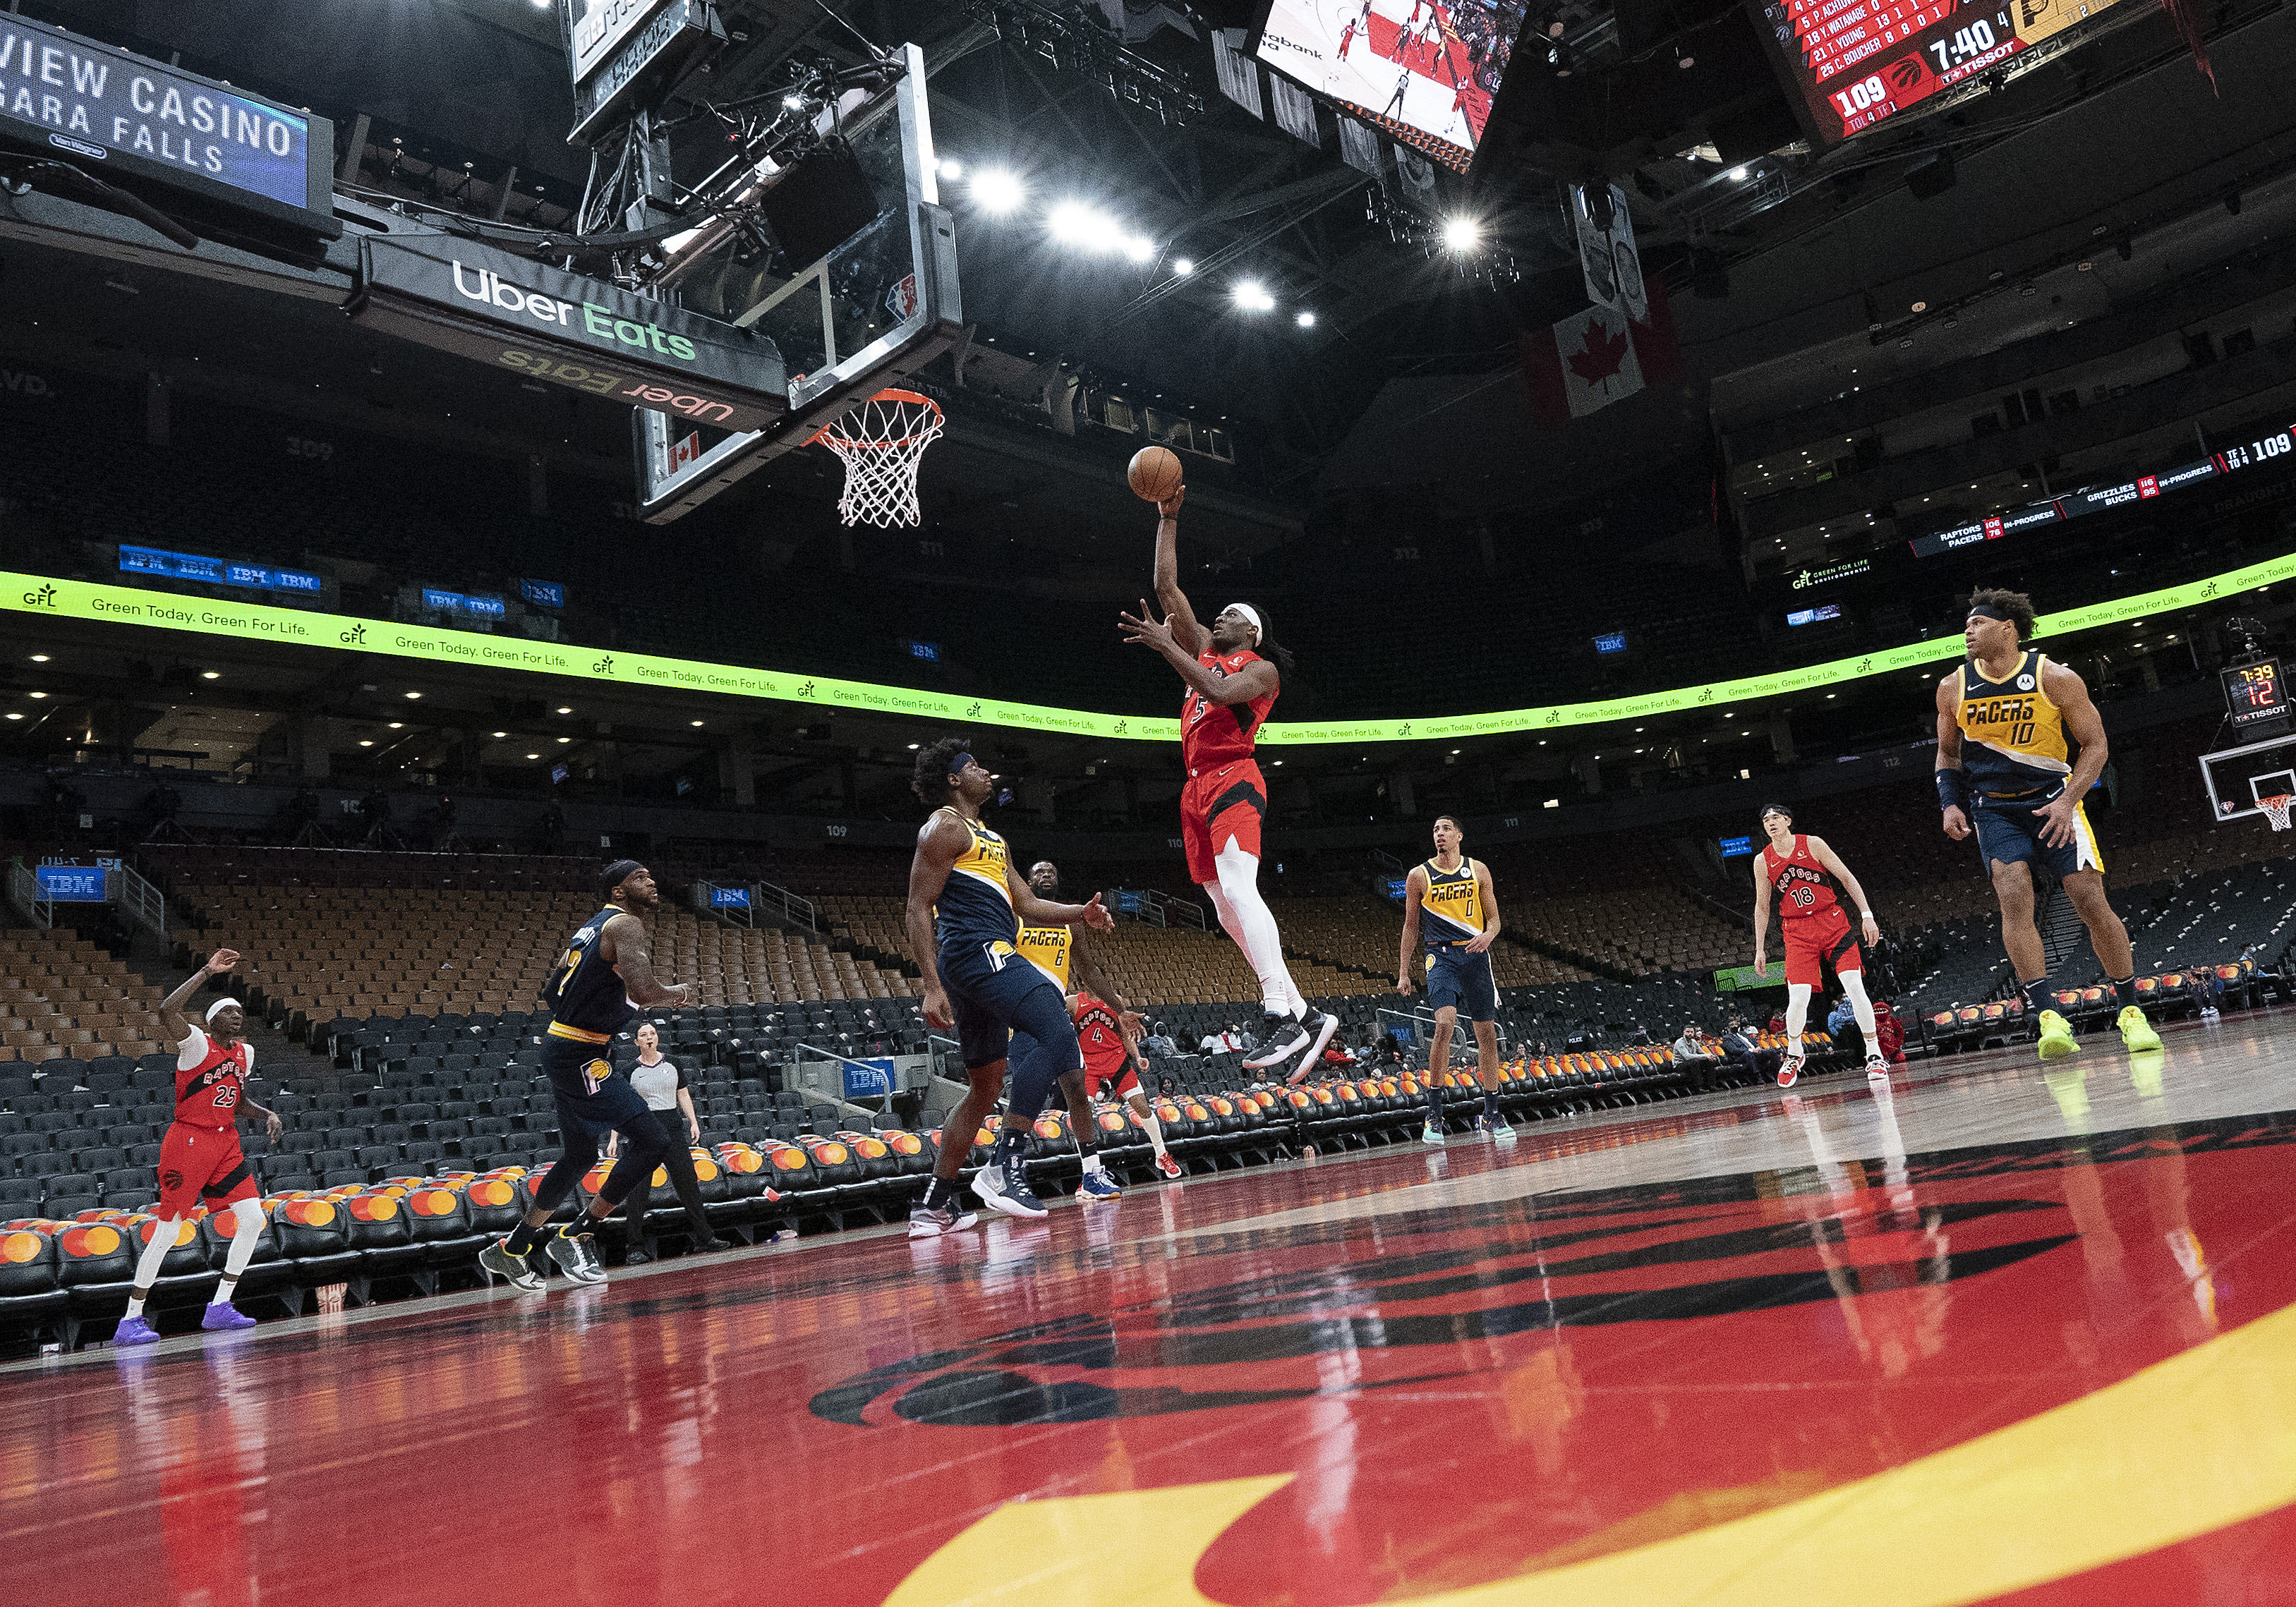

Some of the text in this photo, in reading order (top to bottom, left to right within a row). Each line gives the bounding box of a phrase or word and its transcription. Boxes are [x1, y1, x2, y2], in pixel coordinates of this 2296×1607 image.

[1801, 10, 1824, 29] 5 P.
[1997, 11, 2010, 28] 4
[2080, 5, 2089, 18] 2
[1806, 31, 1821, 47] 18
[1820, 26, 1830, 38] Y.
[1827, 5, 1868, 35] WATANABE
[1813, 48, 1827, 62] 21
[1826, 44, 1837, 55] T.
[1836, 26, 1866, 51] YOUNG
[1875, 13, 1890, 30] 13
[1895, 7, 1903, 19] 1
[1820, 6, 1942, 78] 25 C. BOUCHER 8 8 0 1
[1929, 18, 1995, 71] 7:40
[1961, 41, 2014, 75] TISSOT
[1836, 75, 1887, 118] 109
[131, 77, 290, 157] CASINO
[1867, 112, 1875, 123] 4
[1890, 100, 1897, 112] 1
[114, 117, 222, 172] FALLS
[452, 260, 696, 360] Uber Eats
[2227, 447, 2247, 460] TF 1
[2252, 433, 2291, 461] 109
[2228, 456, 2249, 470] TO 4
[2087, 483, 2136, 502] GRIZZLIES
[2158, 464, 2213, 487] IN-PROGRESS
[2105, 487, 2156, 506] BUCKS 95
[1940, 510, 2055, 541] RAPTORS 106 IN-PROGRESS
[1948, 533, 1983, 547] PACERS
[233, 567, 266, 584] IBM
[1792, 571, 1813, 589] GFL
[1813, 568, 1835, 578] GREEN
[1854, 559, 1868, 567] LIFE
[281, 574, 313, 590] IBM
[2201, 573, 2265, 598] GFL Green
[23, 585, 309, 636] GFL Green Today. Green For Life.
[2058, 596, 2182, 628] Green Today. Green For Life.
[340, 625, 569, 667] GFL Green Today. Green For Life.
[1857, 648, 1944, 674] GFL Green Today.
[593, 656, 778, 692] GFL Green Today. Green For Life.
[2240, 665, 2274, 683] 7:39
[797, 681, 815, 698] GFL
[833, 689, 859, 702] Green
[862, 693, 889, 705] Today.
[892, 697, 917, 709] Green
[919, 700, 931, 711] For
[1698, 669, 1839, 703] GFL Green Today. Green For Life.
[2248, 680, 2274, 705] 12
[966, 703, 981, 717] GFL
[997, 710, 1019, 722] Green
[1046, 716, 1067, 727] Green
[1069, 718, 1080, 728] For
[1082, 720, 1096, 729] Life.
[1546, 711, 1560, 724] GFL
[1575, 710, 1597, 720] Green
[1600, 708, 1624, 717] Today.
[1626, 703, 1649, 712] Green
[1666, 698, 1682, 707] Life.
[1966, 698, 2035, 725] PACERS
[2248, 705, 2287, 720] TISSOT
[1113, 721, 1164, 736] GFL Green
[1281, 731, 1303, 739] Green
[1305, 731, 1329, 740] Today.
[1398, 724, 1412, 736] GFL
[1426, 725, 1449, 734] Green
[1451, 724, 1475, 733] Today.
[1476, 720, 1499, 730] Green
[2011, 722, 2035, 746] 10
[826, 825, 847, 837] 109
[47, 875, 95, 893] IBM
[1777, 867, 1820, 893] RAPTORS
[1431, 883, 1474, 902] PACERS
[1790, 886, 1815, 908] 18
[1466, 900, 1473, 918] 0
[1021, 930, 1065, 947] PACERS
[1055, 949, 1065, 968] 6
[1092, 1027, 1102, 1043] 4
[851, 1069, 886, 1088] IBM
[212, 1085, 237, 1108] 25
